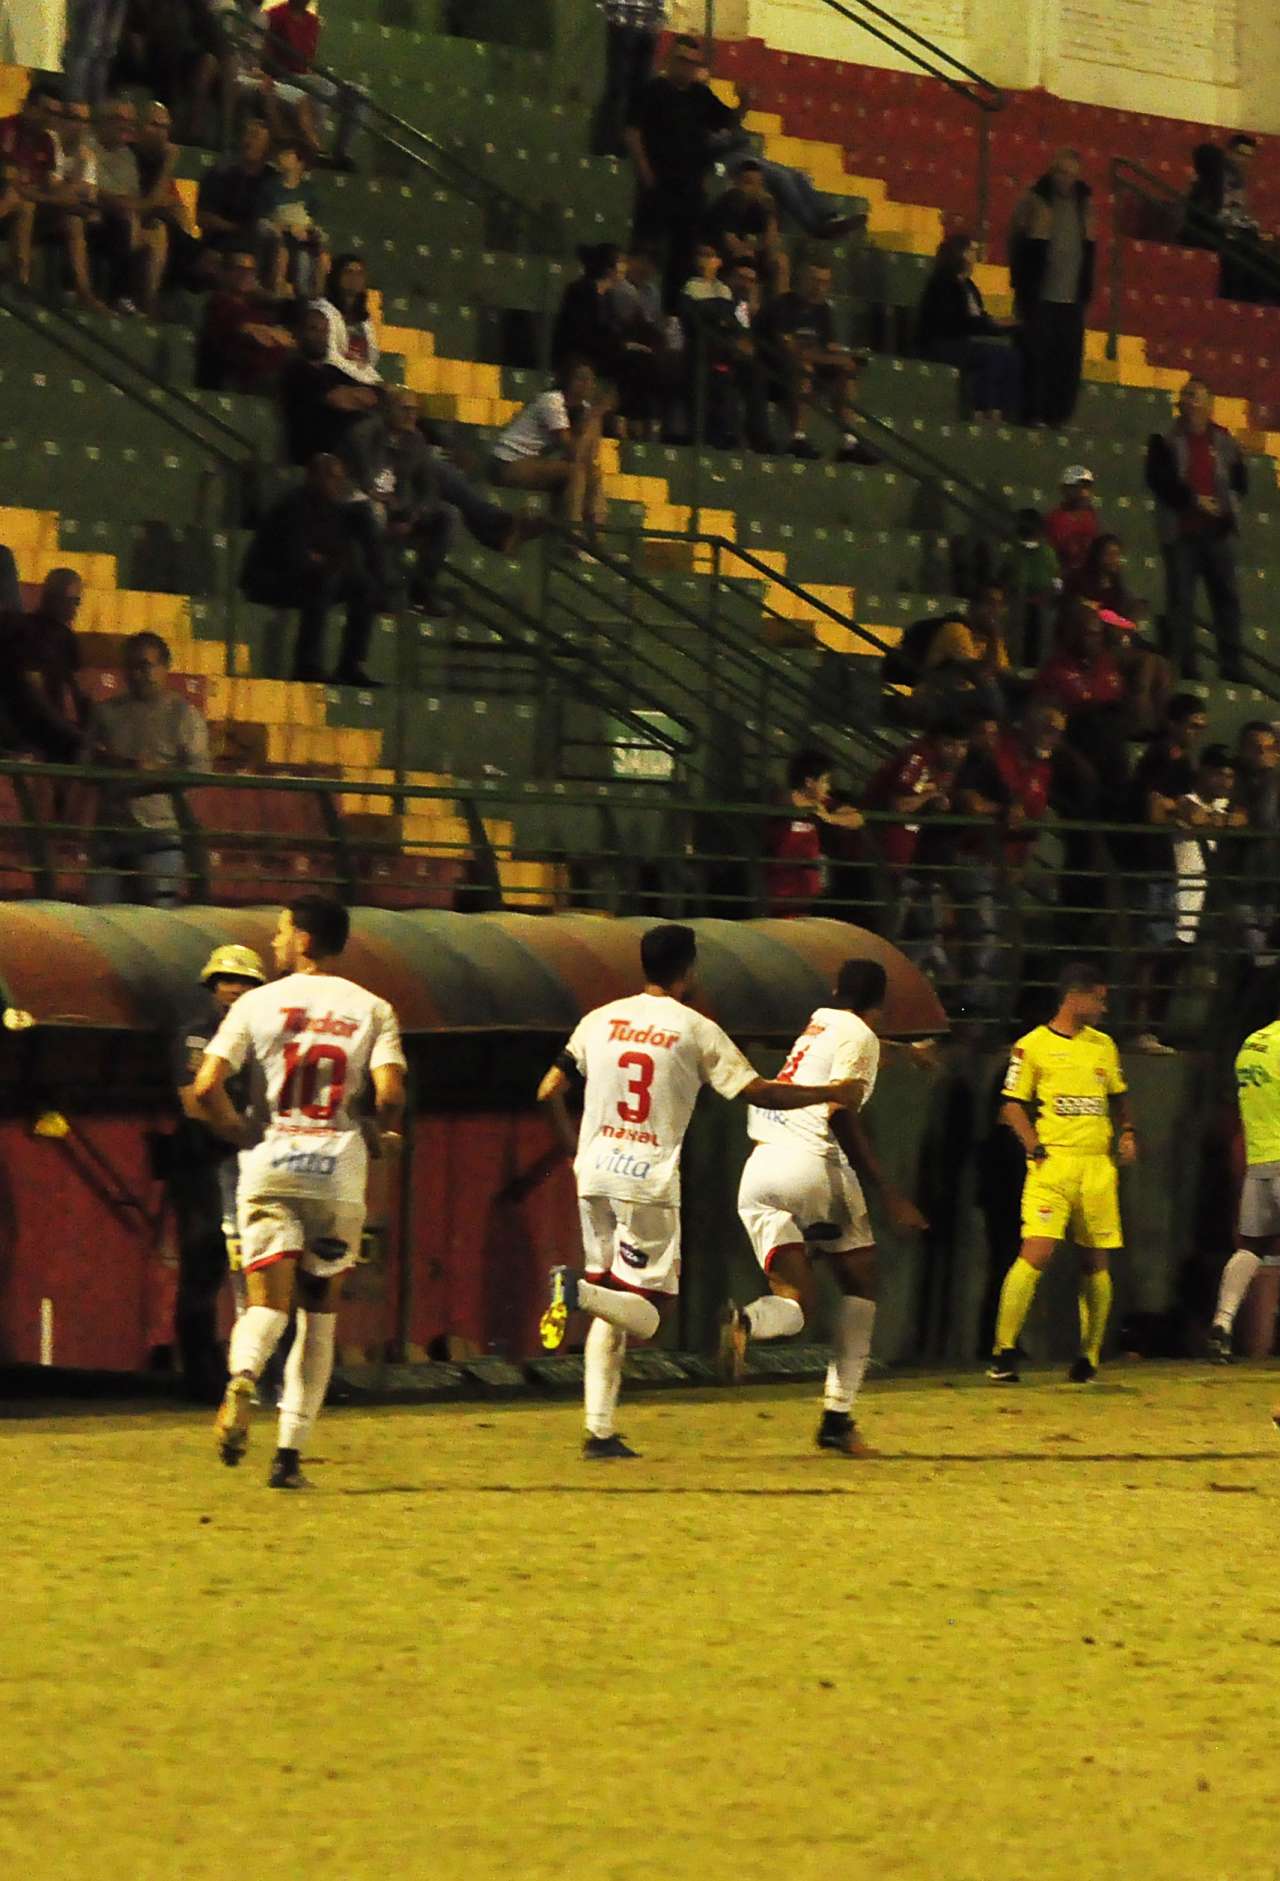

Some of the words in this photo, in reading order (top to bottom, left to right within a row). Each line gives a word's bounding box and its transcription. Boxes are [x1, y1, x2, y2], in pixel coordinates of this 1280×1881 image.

[608, 1019, 679, 1049] Tudor
[279, 1042, 347, 1120] 10
[617, 1051, 654, 1124] 3
[596, 1148, 651, 1180] vitta
